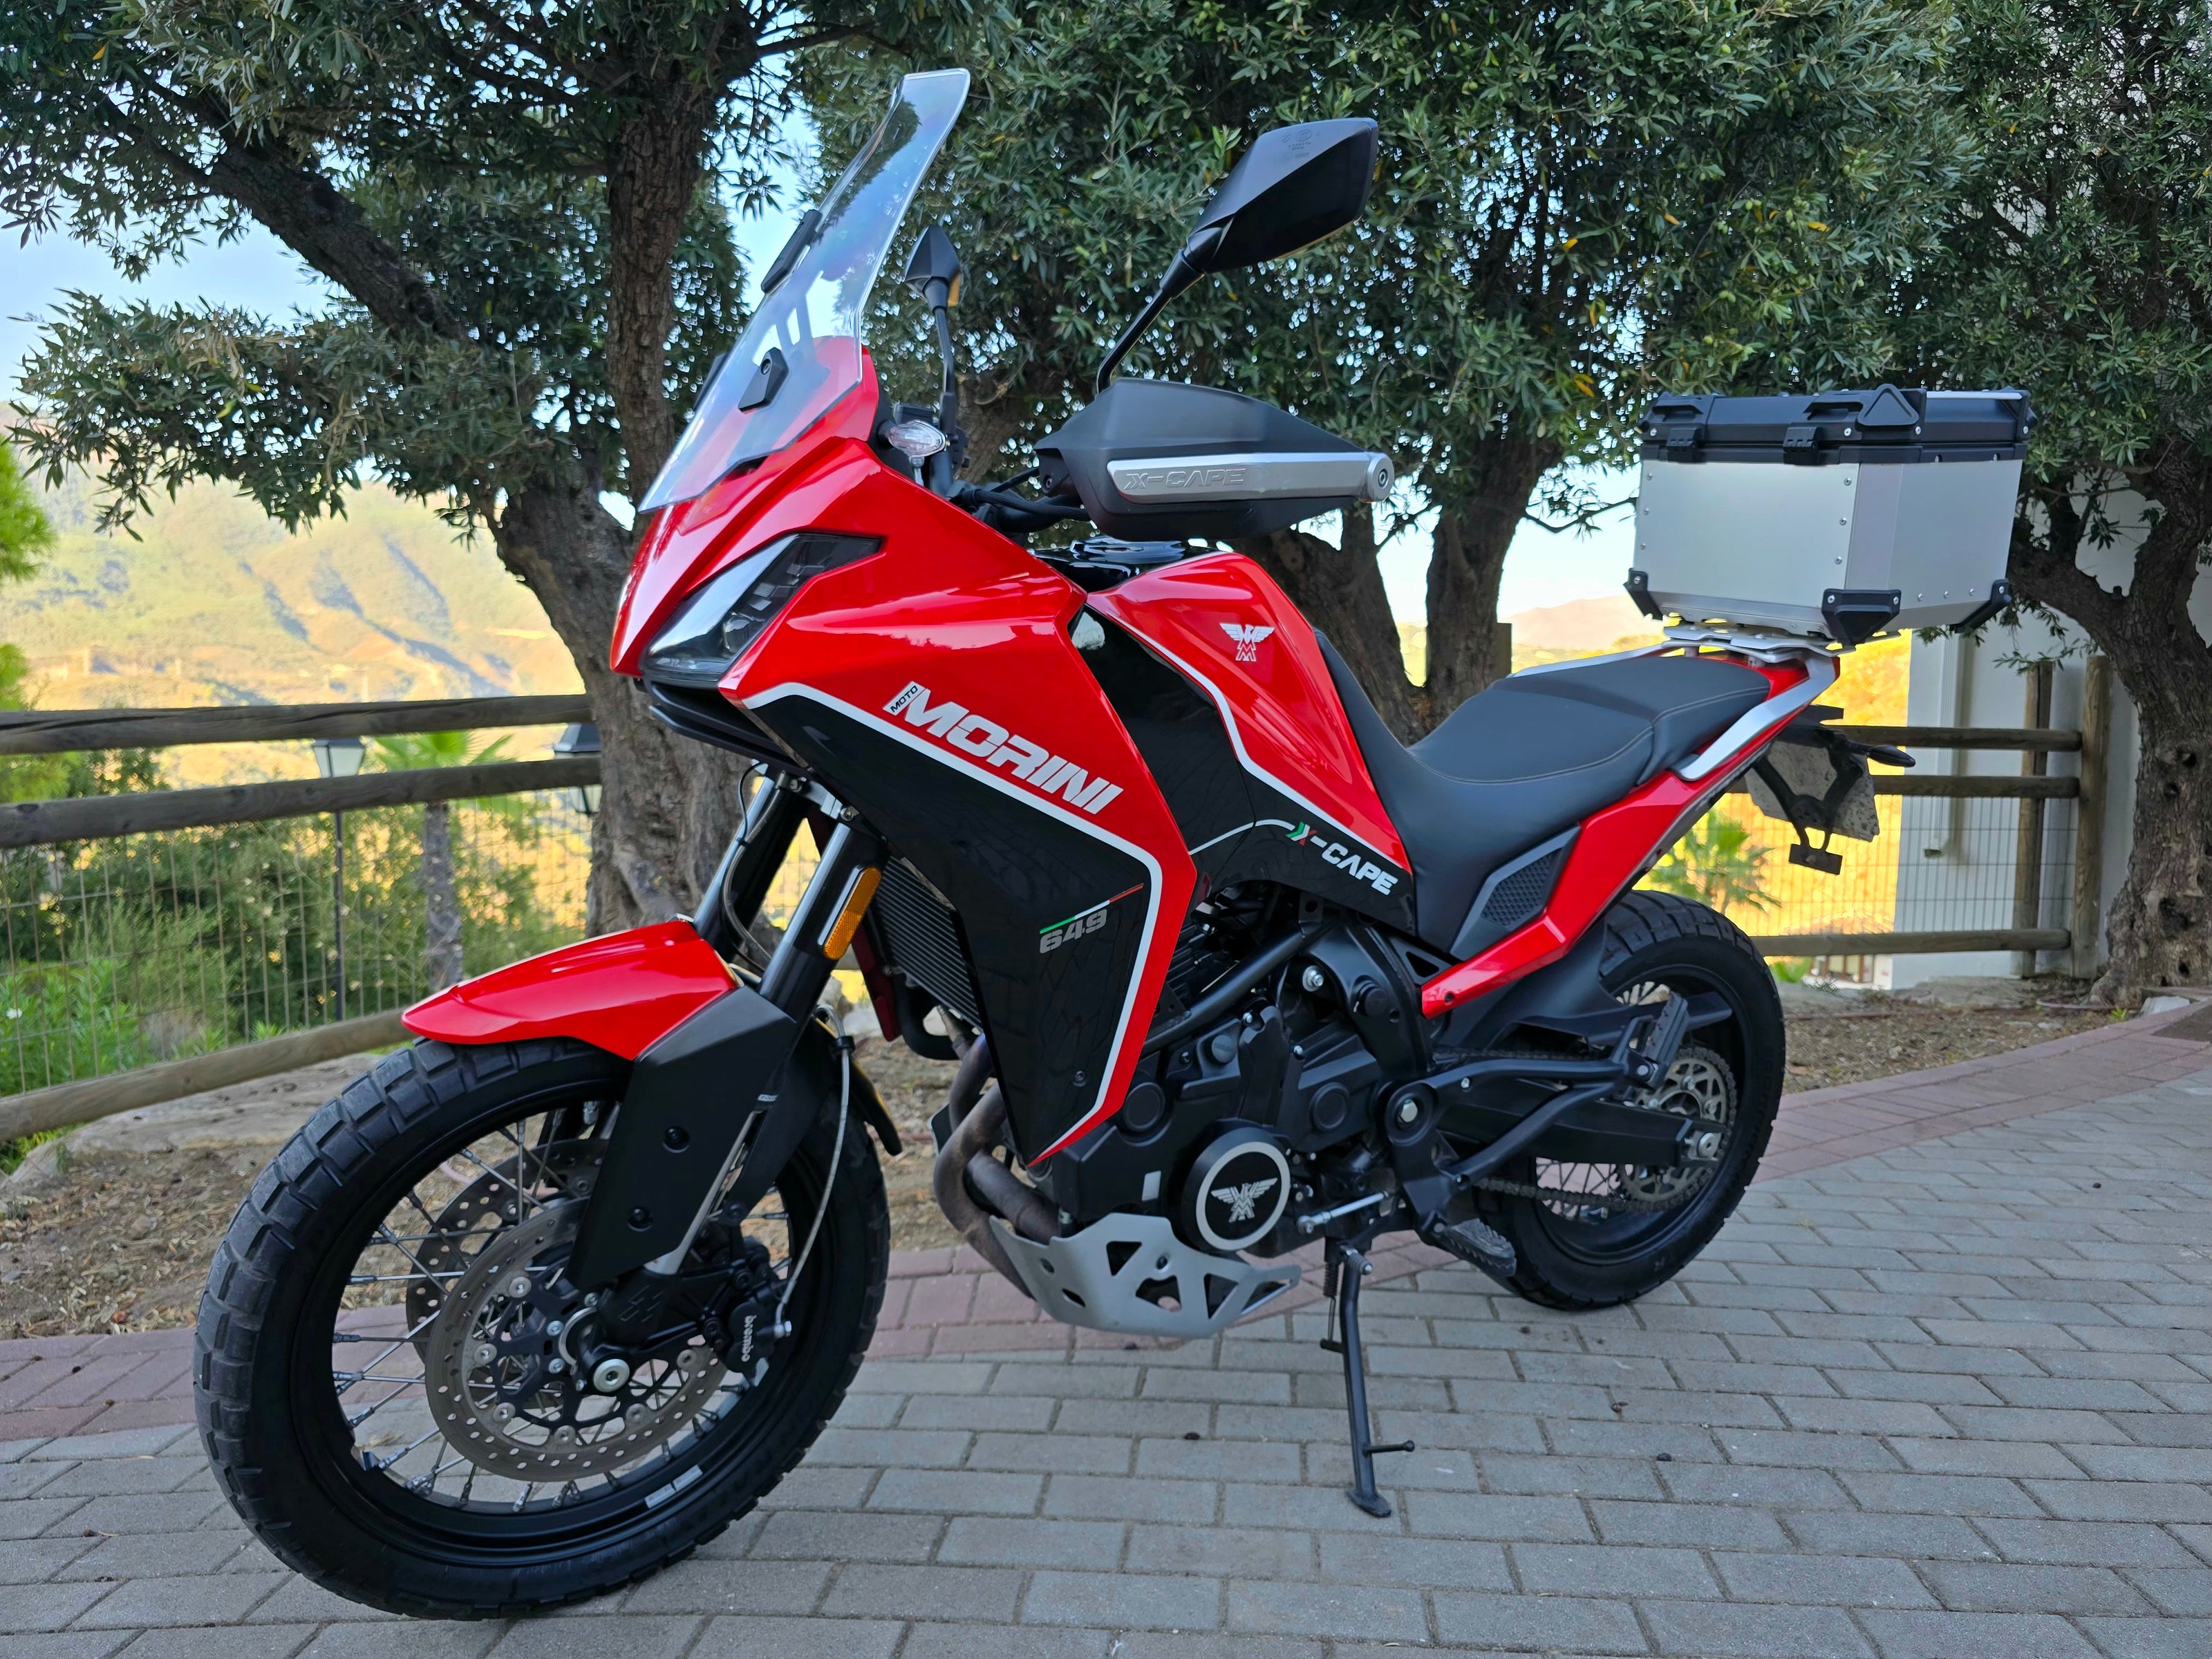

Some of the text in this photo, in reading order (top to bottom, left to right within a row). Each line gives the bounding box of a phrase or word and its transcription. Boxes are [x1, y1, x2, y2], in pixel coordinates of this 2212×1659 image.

[1123, 468, 1246, 490] X-CAPE
[890, 685, 1124, 815] MOTO MORINI
[1285, 821, 1399, 896] X-CAPE
[1040, 909, 1107, 954] 649
[741, 1315, 757, 1362] brembo
